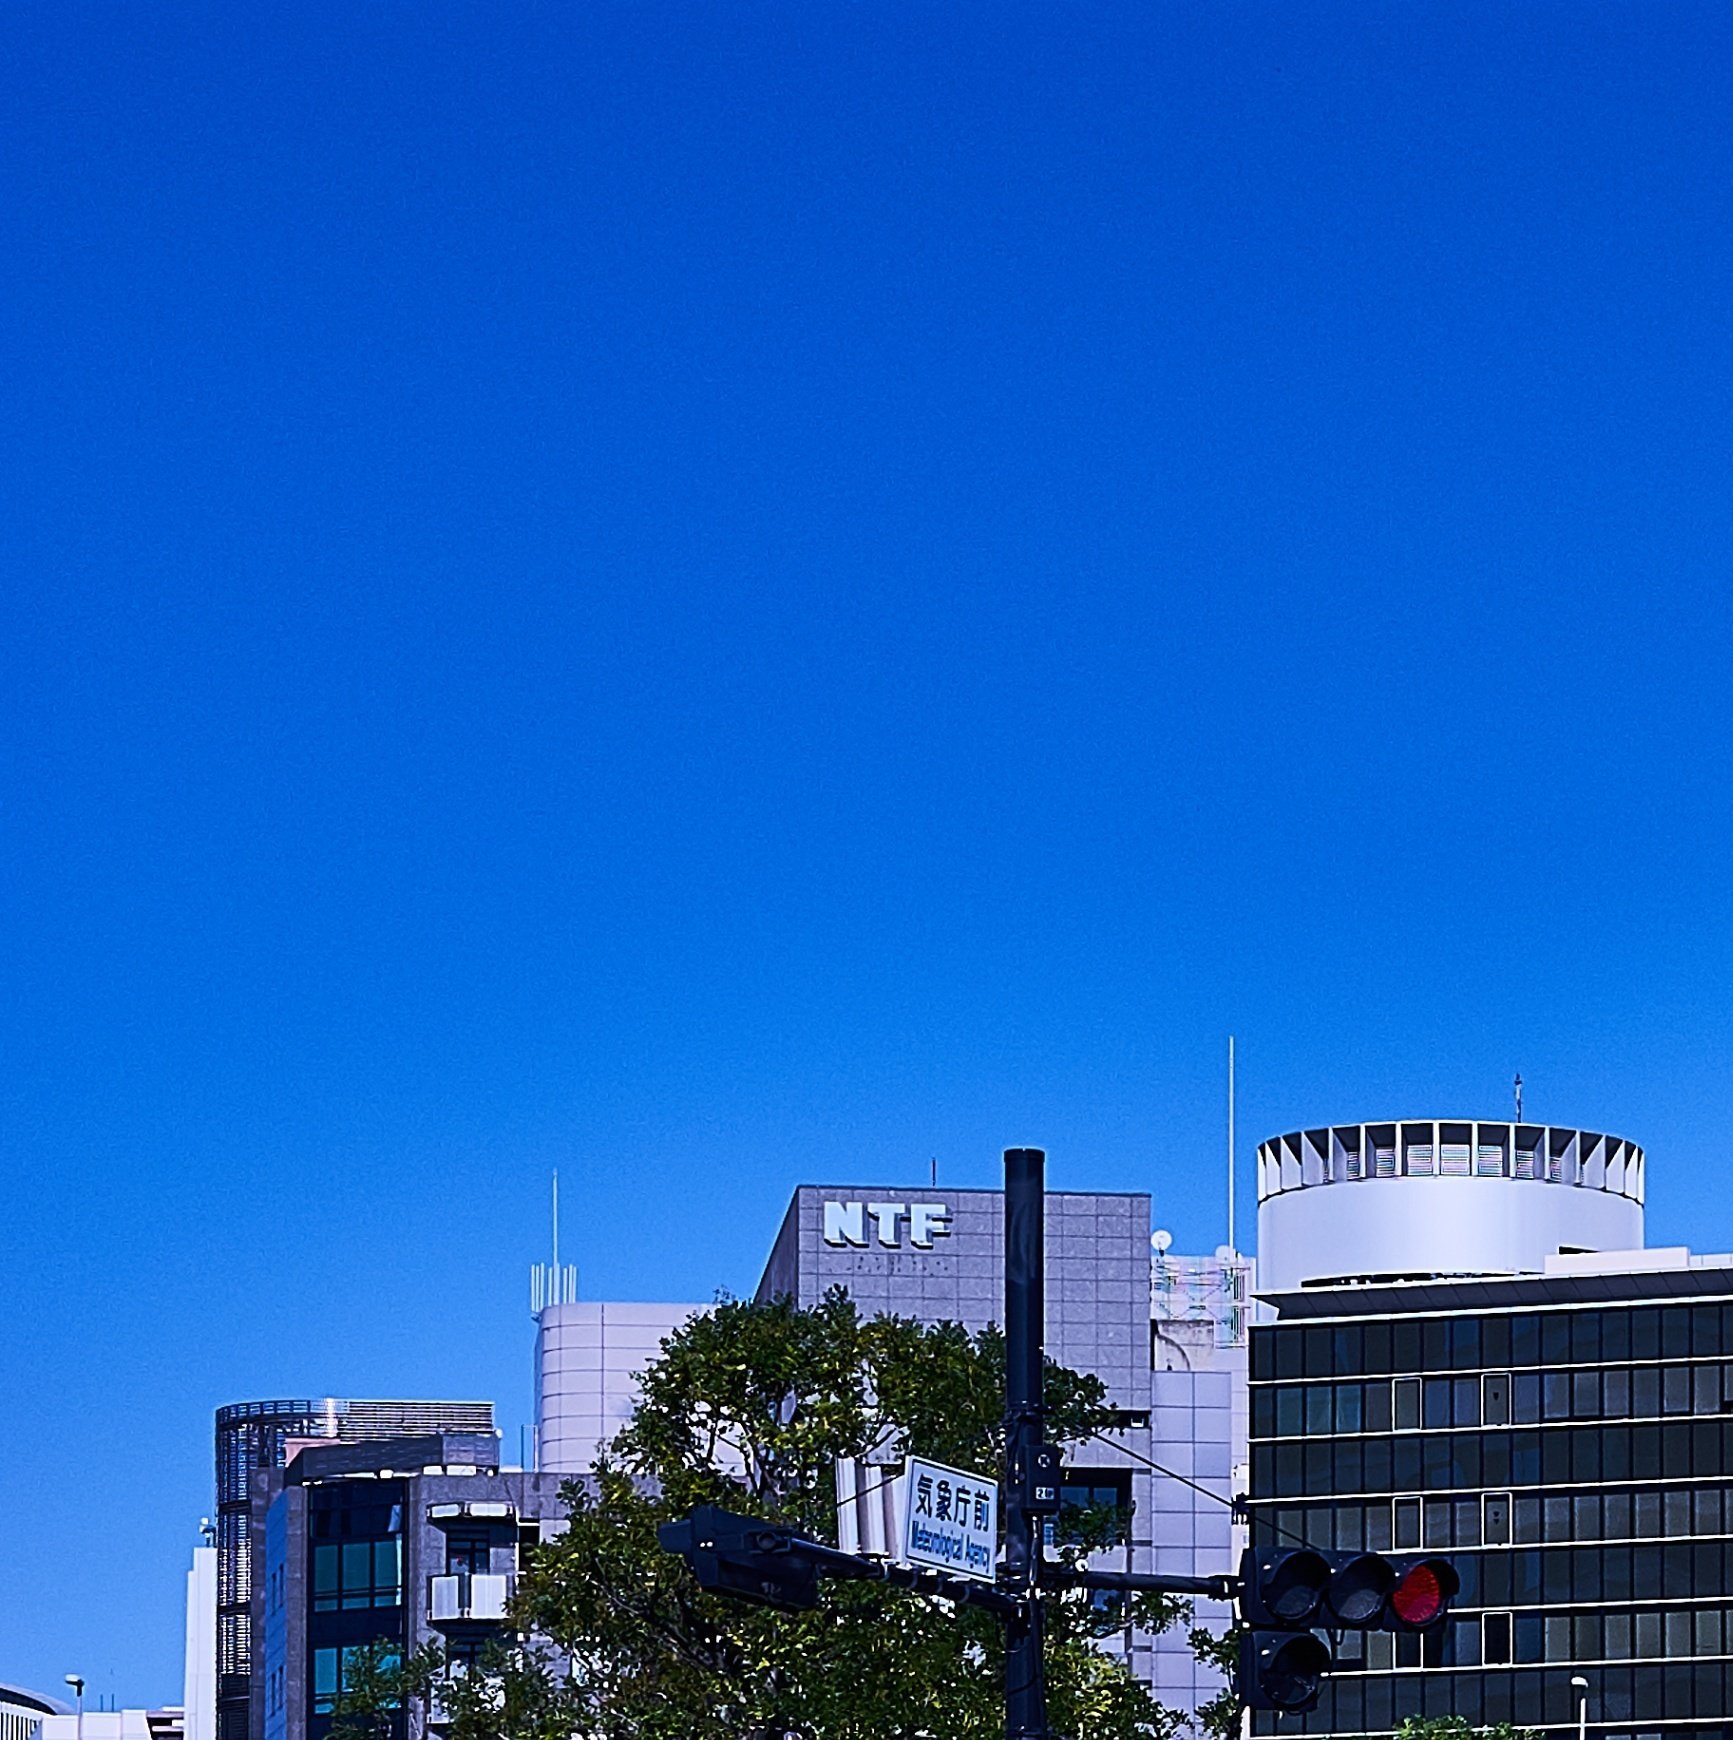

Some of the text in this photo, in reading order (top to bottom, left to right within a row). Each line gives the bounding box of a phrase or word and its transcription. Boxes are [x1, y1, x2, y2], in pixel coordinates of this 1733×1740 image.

[824, 1201, 950, 1247] NTF
[915, 1472, 990, 1532] 気象庁前
